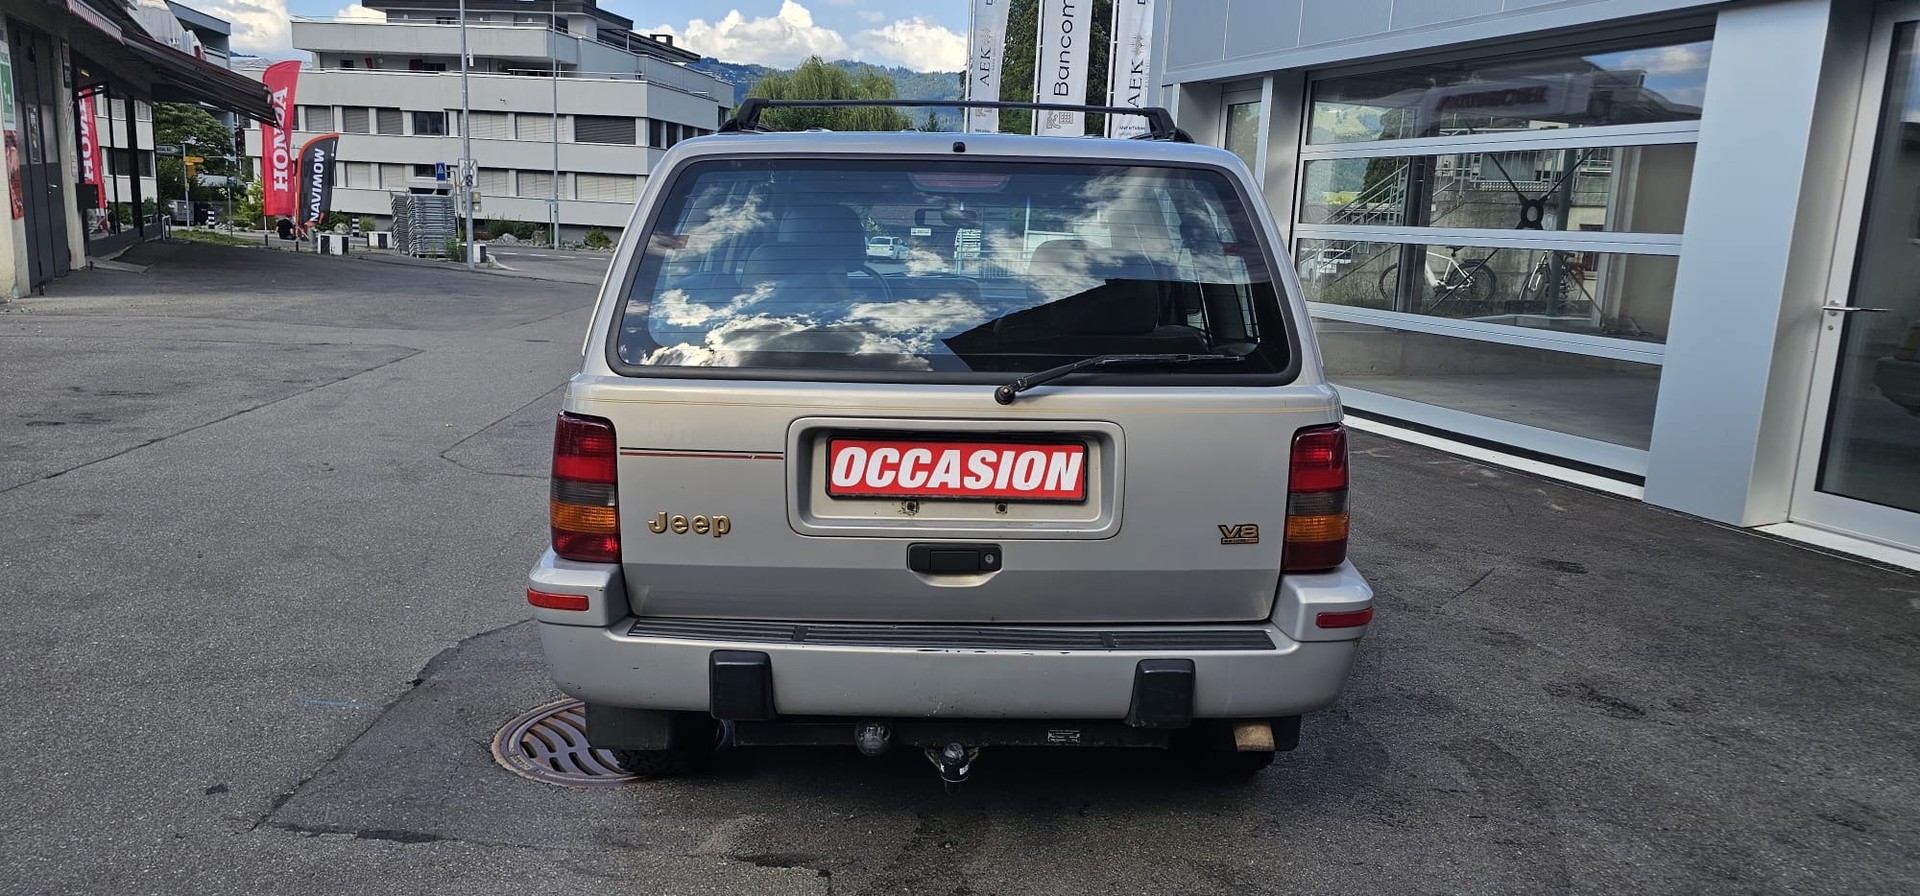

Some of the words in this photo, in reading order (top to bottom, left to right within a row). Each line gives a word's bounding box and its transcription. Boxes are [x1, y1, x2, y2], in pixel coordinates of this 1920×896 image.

[979, 47, 992, 87] AEK
[1127, 58, 1144, 108] AEK
[272, 86, 289, 192] HONDA
[310, 147, 325, 222] NAVIMOW
[831, 446, 1084, 491] OCCASION
[648, 511, 731, 538] Jeep
[1218, 524, 1259, 539] V8
